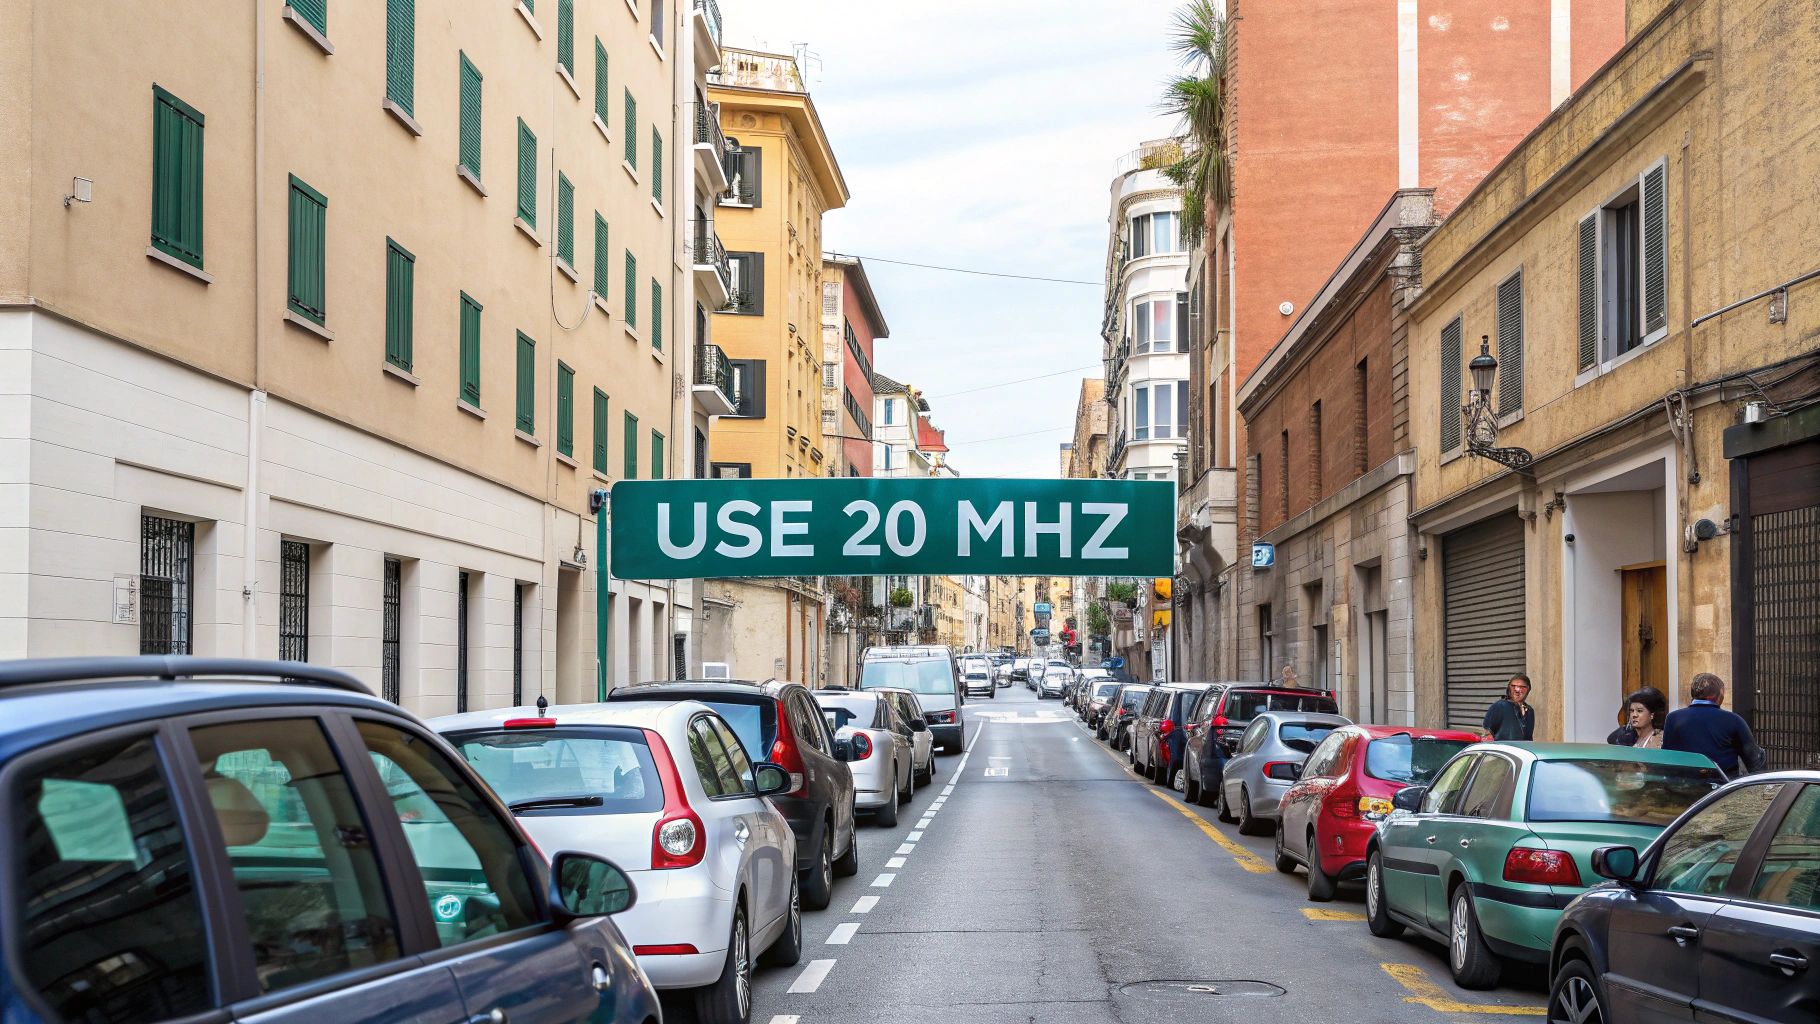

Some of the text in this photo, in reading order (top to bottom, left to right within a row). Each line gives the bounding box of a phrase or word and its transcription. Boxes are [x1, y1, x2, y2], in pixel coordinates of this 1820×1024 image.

[656, 499, 1129, 560] USE 20 MHZ
